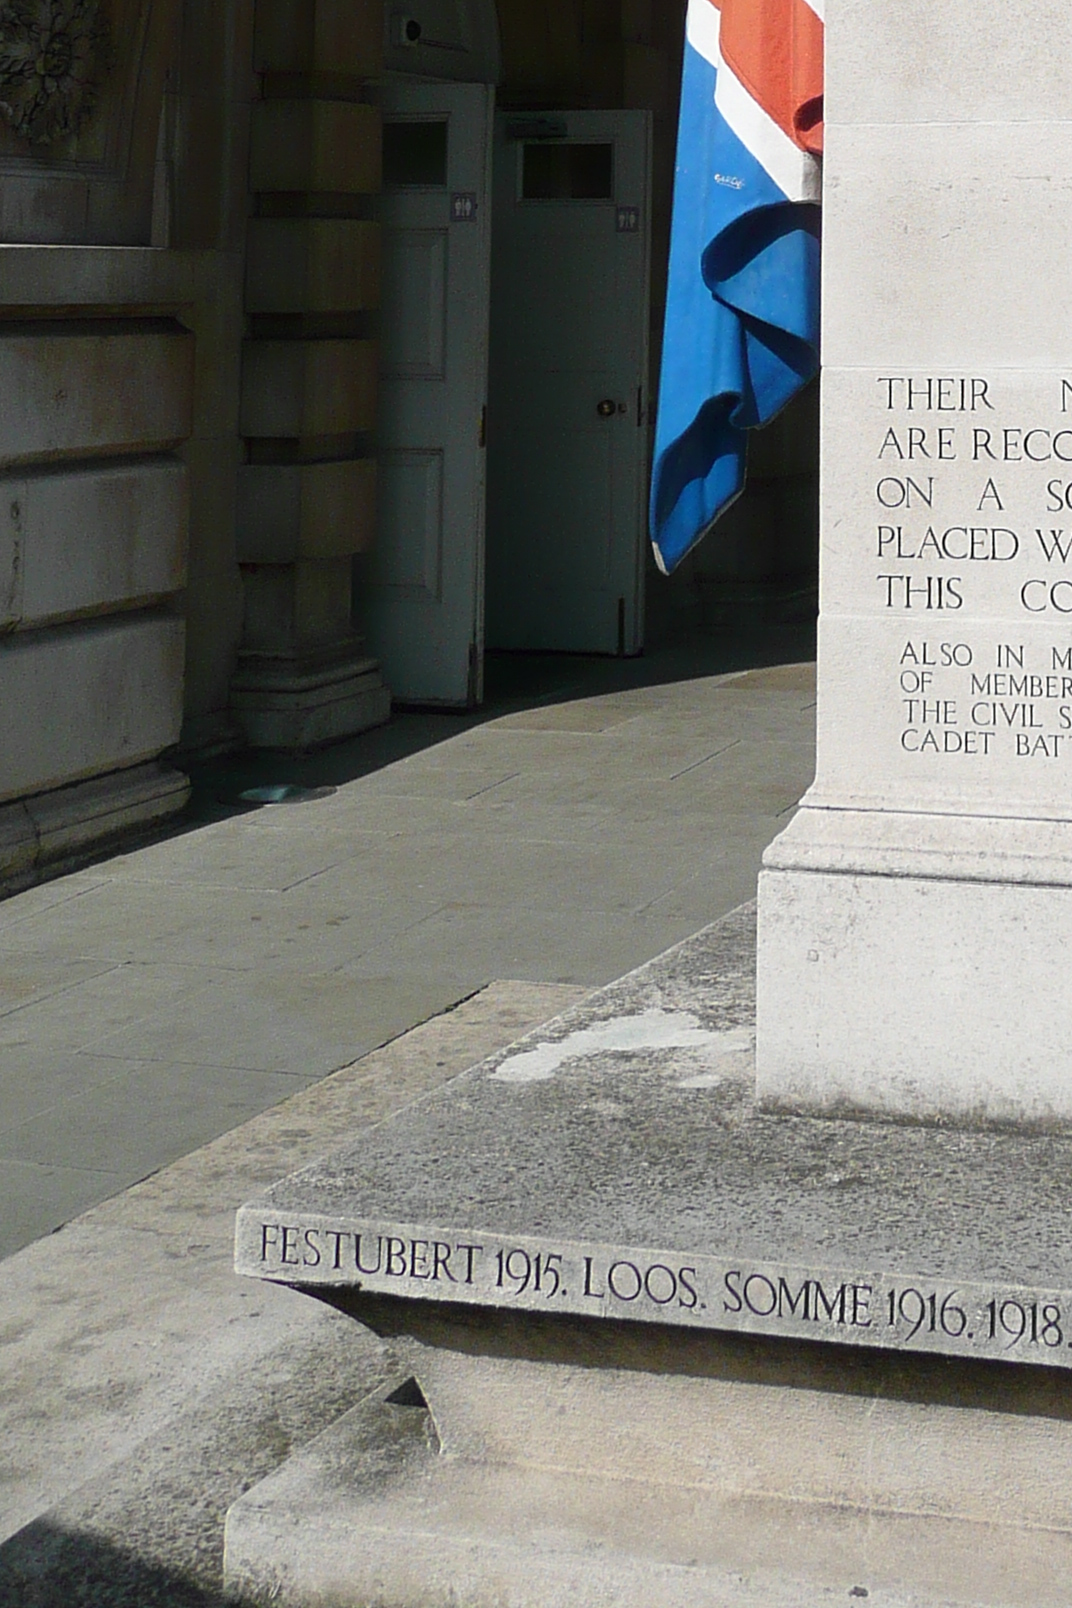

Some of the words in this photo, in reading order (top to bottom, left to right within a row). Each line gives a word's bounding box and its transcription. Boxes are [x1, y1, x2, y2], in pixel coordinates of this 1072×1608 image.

[877, 378, 995, 411] THEIR
[877, 428, 956, 460] ARE
[877, 477, 934, 508] ON
[977, 478, 1004, 511] A
[877, 526, 1019, 561] PLACED
[877, 575, 963, 609] THIS
[900, 642, 972, 667] ALSO
[998, 645, 1024, 669] IN
[900, 670, 933, 693] OF
[903, 699, 957, 725] THE
[971, 702, 1043, 729] CIVIL
[901, 729, 995, 754] CADET
[260, 1224, 484, 1284] FESTUBERT
[584, 1257, 706, 1310] LOOS.
[722, 1271, 872, 1327] SOMME
[885, 1288, 974, 1342] 1916.
